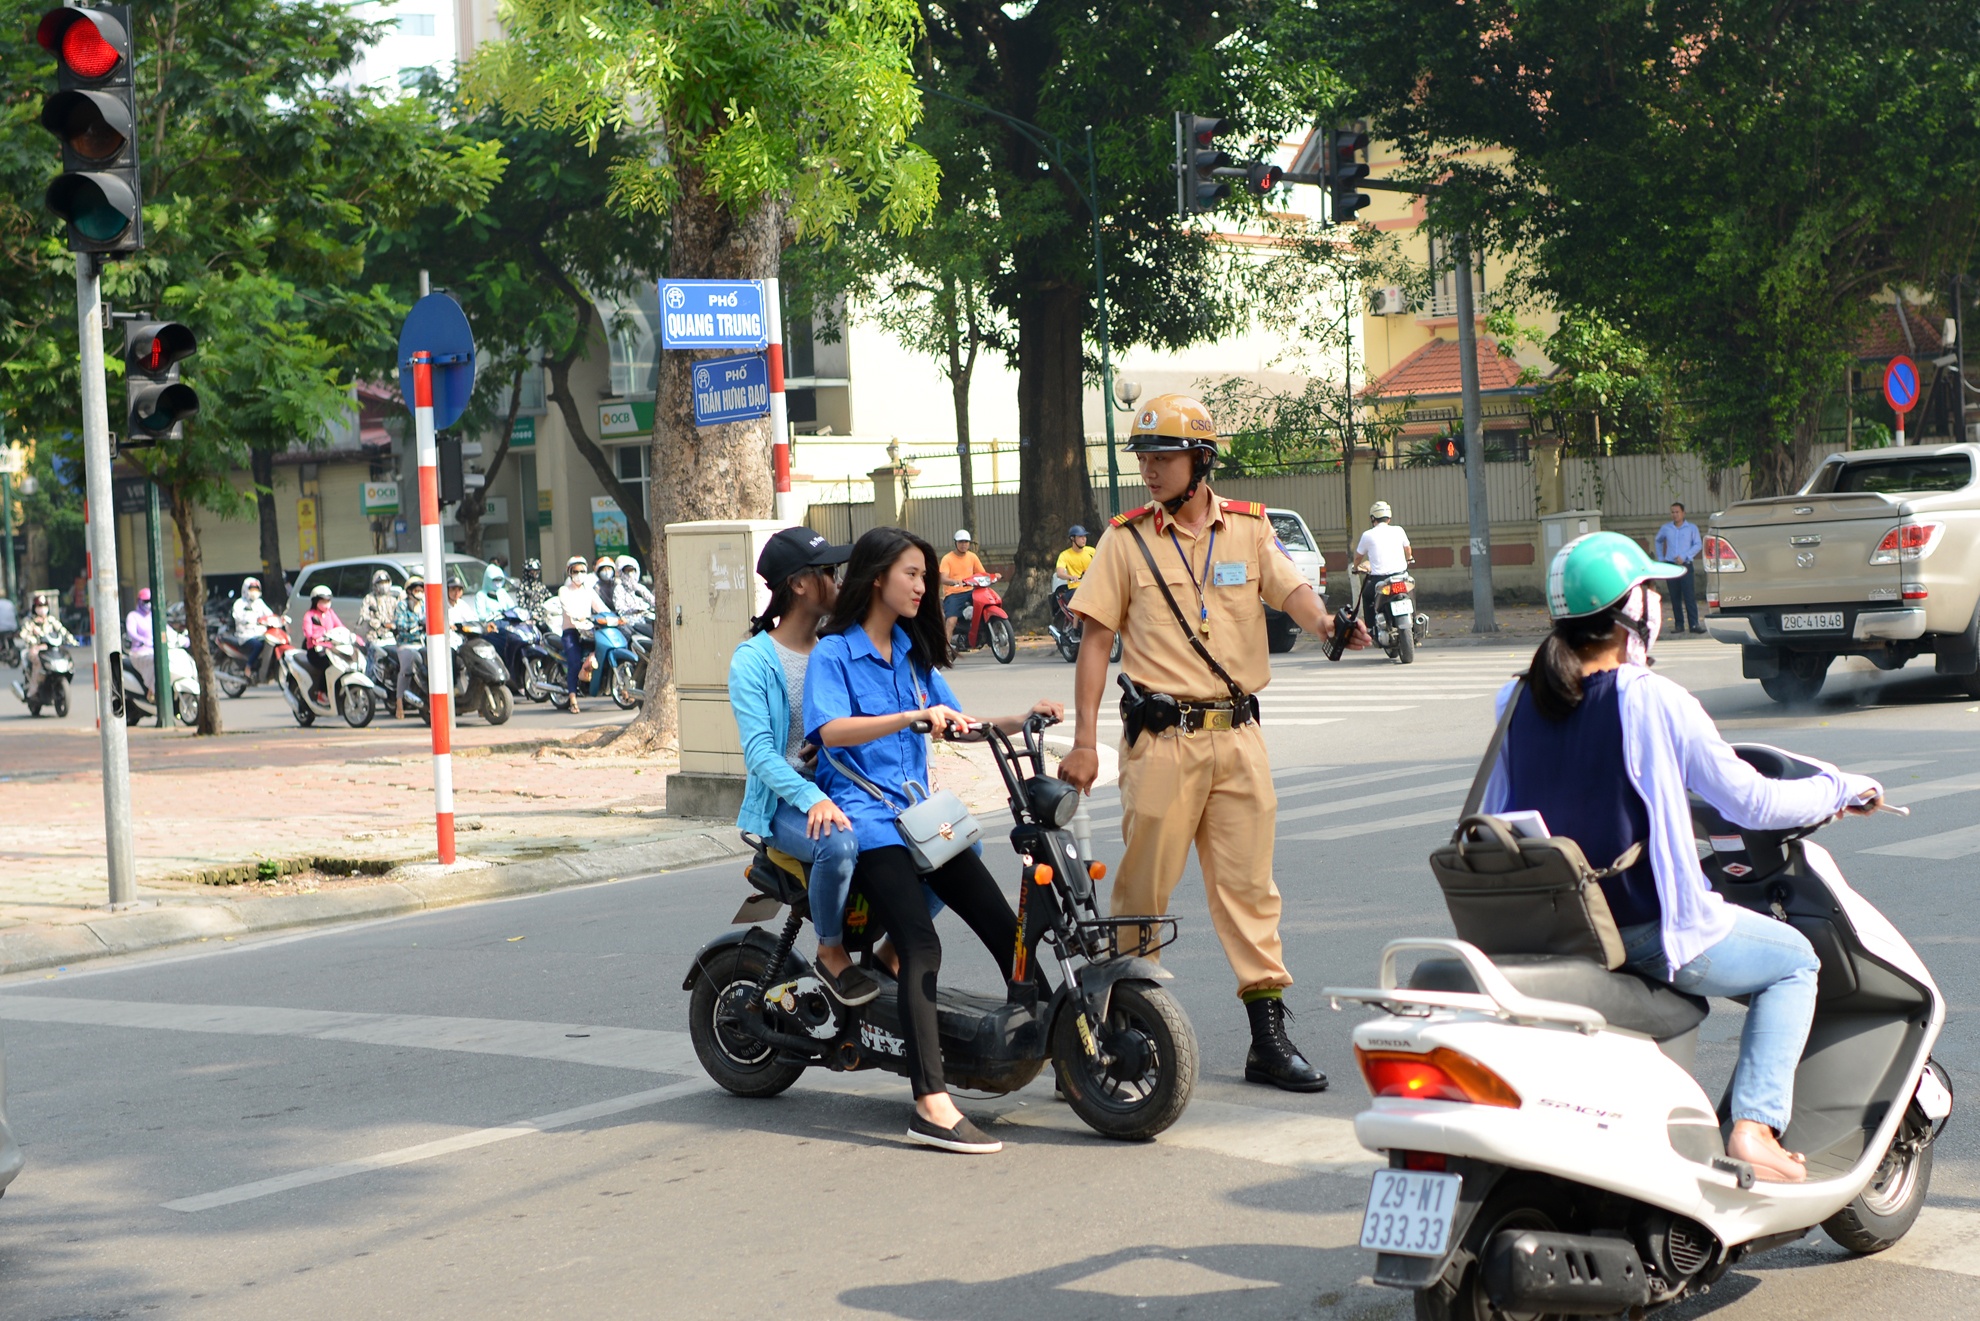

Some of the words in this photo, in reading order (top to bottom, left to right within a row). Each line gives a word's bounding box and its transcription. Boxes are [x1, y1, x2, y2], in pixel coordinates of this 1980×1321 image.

[709, 291, 738, 307] PHỐ
[668, 313, 714, 338] QUANG
[717, 313, 761, 336] TRUNG
[726, 364, 747, 382] PHỐ
[698, 386, 722, 415] TRẦN
[723, 386, 747, 411] HƯNG
[747, 383, 766, 410] ĐẠO
[611, 412, 630, 424] OCB
[1191, 419, 1213, 432] CSG
[377, 487, 397, 497] OCB
[1784, 614, 1842, 629] 29C-419.48
[1368, 1039, 1412, 1048] HONDA
[1366, 1212, 1444, 1251] 333.33
